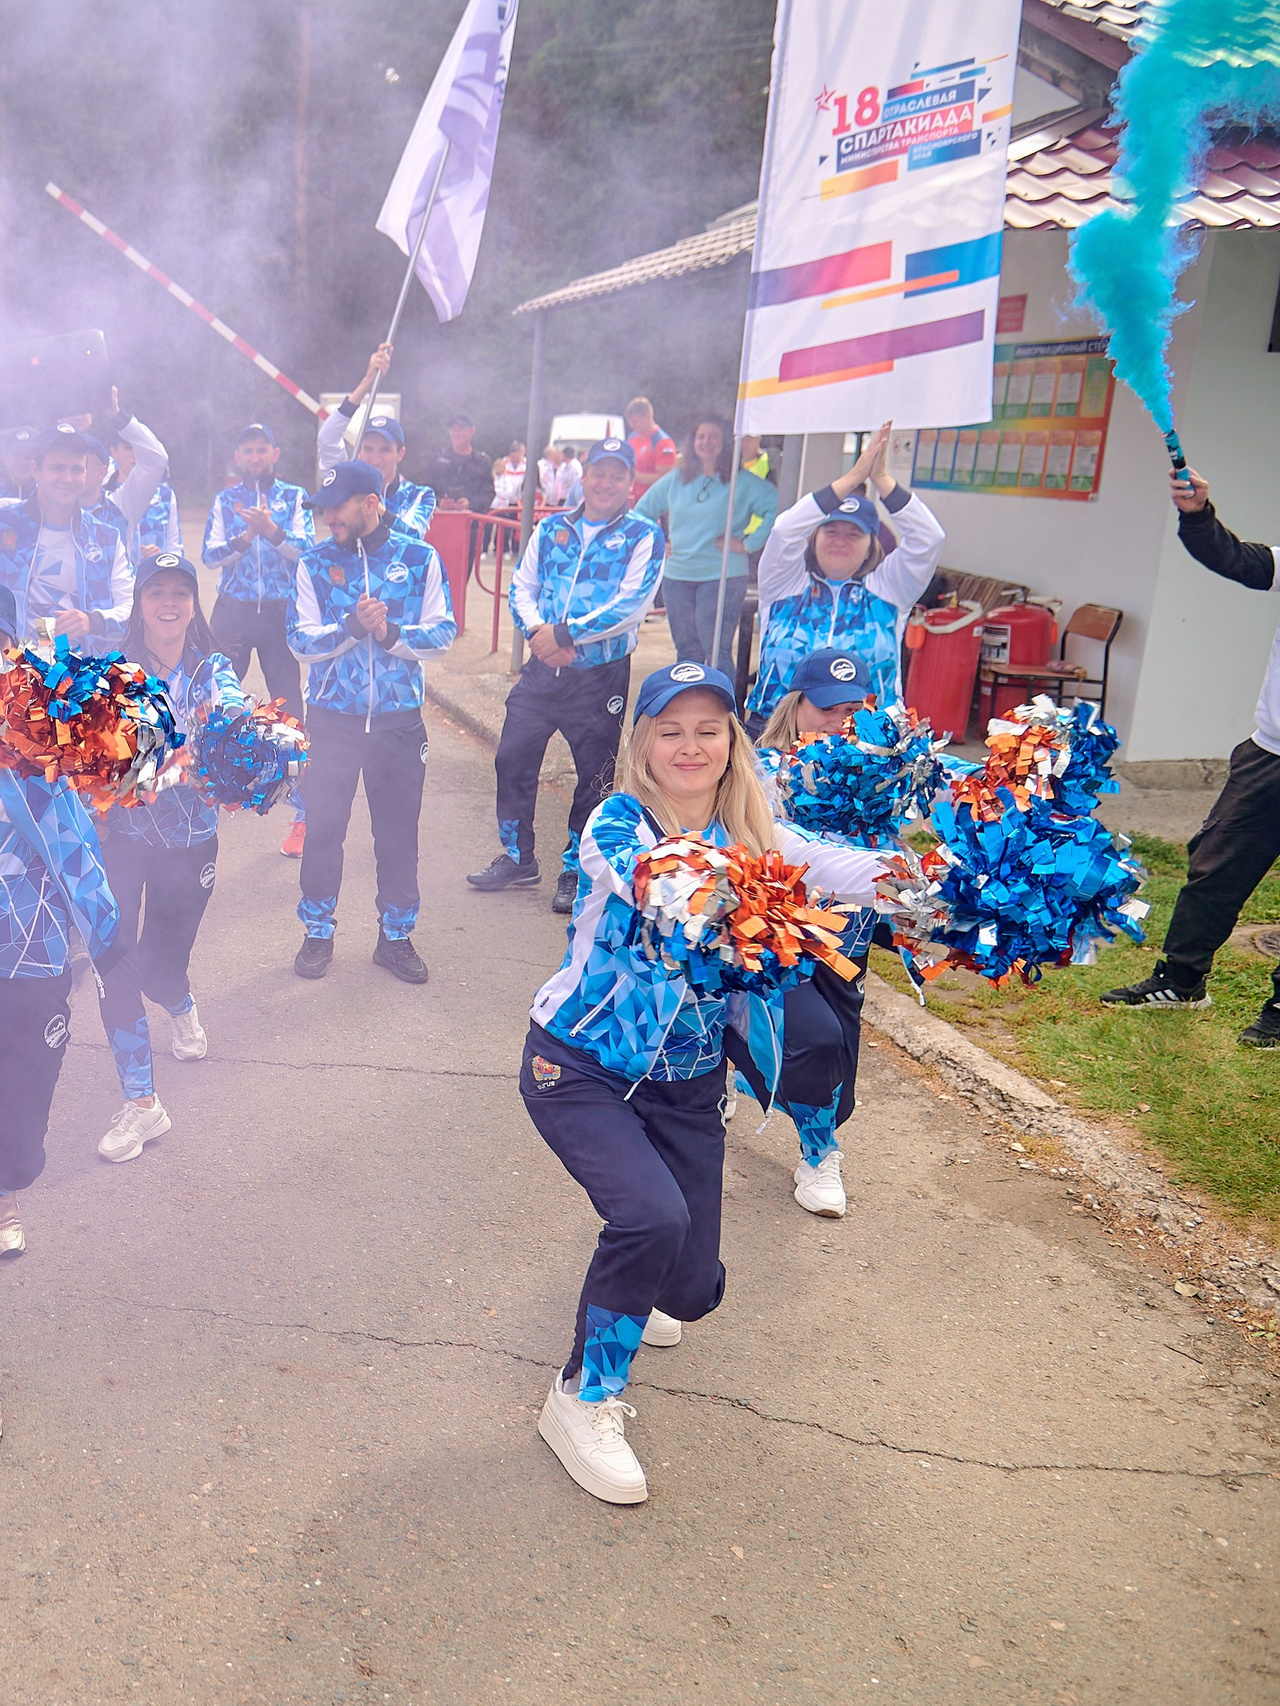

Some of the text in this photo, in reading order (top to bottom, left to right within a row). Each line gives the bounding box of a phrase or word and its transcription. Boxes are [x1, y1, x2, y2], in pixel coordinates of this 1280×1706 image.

[832, 86, 881, 136] 18
[883, 89, 957, 119] ОТРАСЛЕВАЯ
[839, 106, 973, 154] СПАРТАКИАДА
[901, 126, 959, 148] ТРАНСПОРТА
